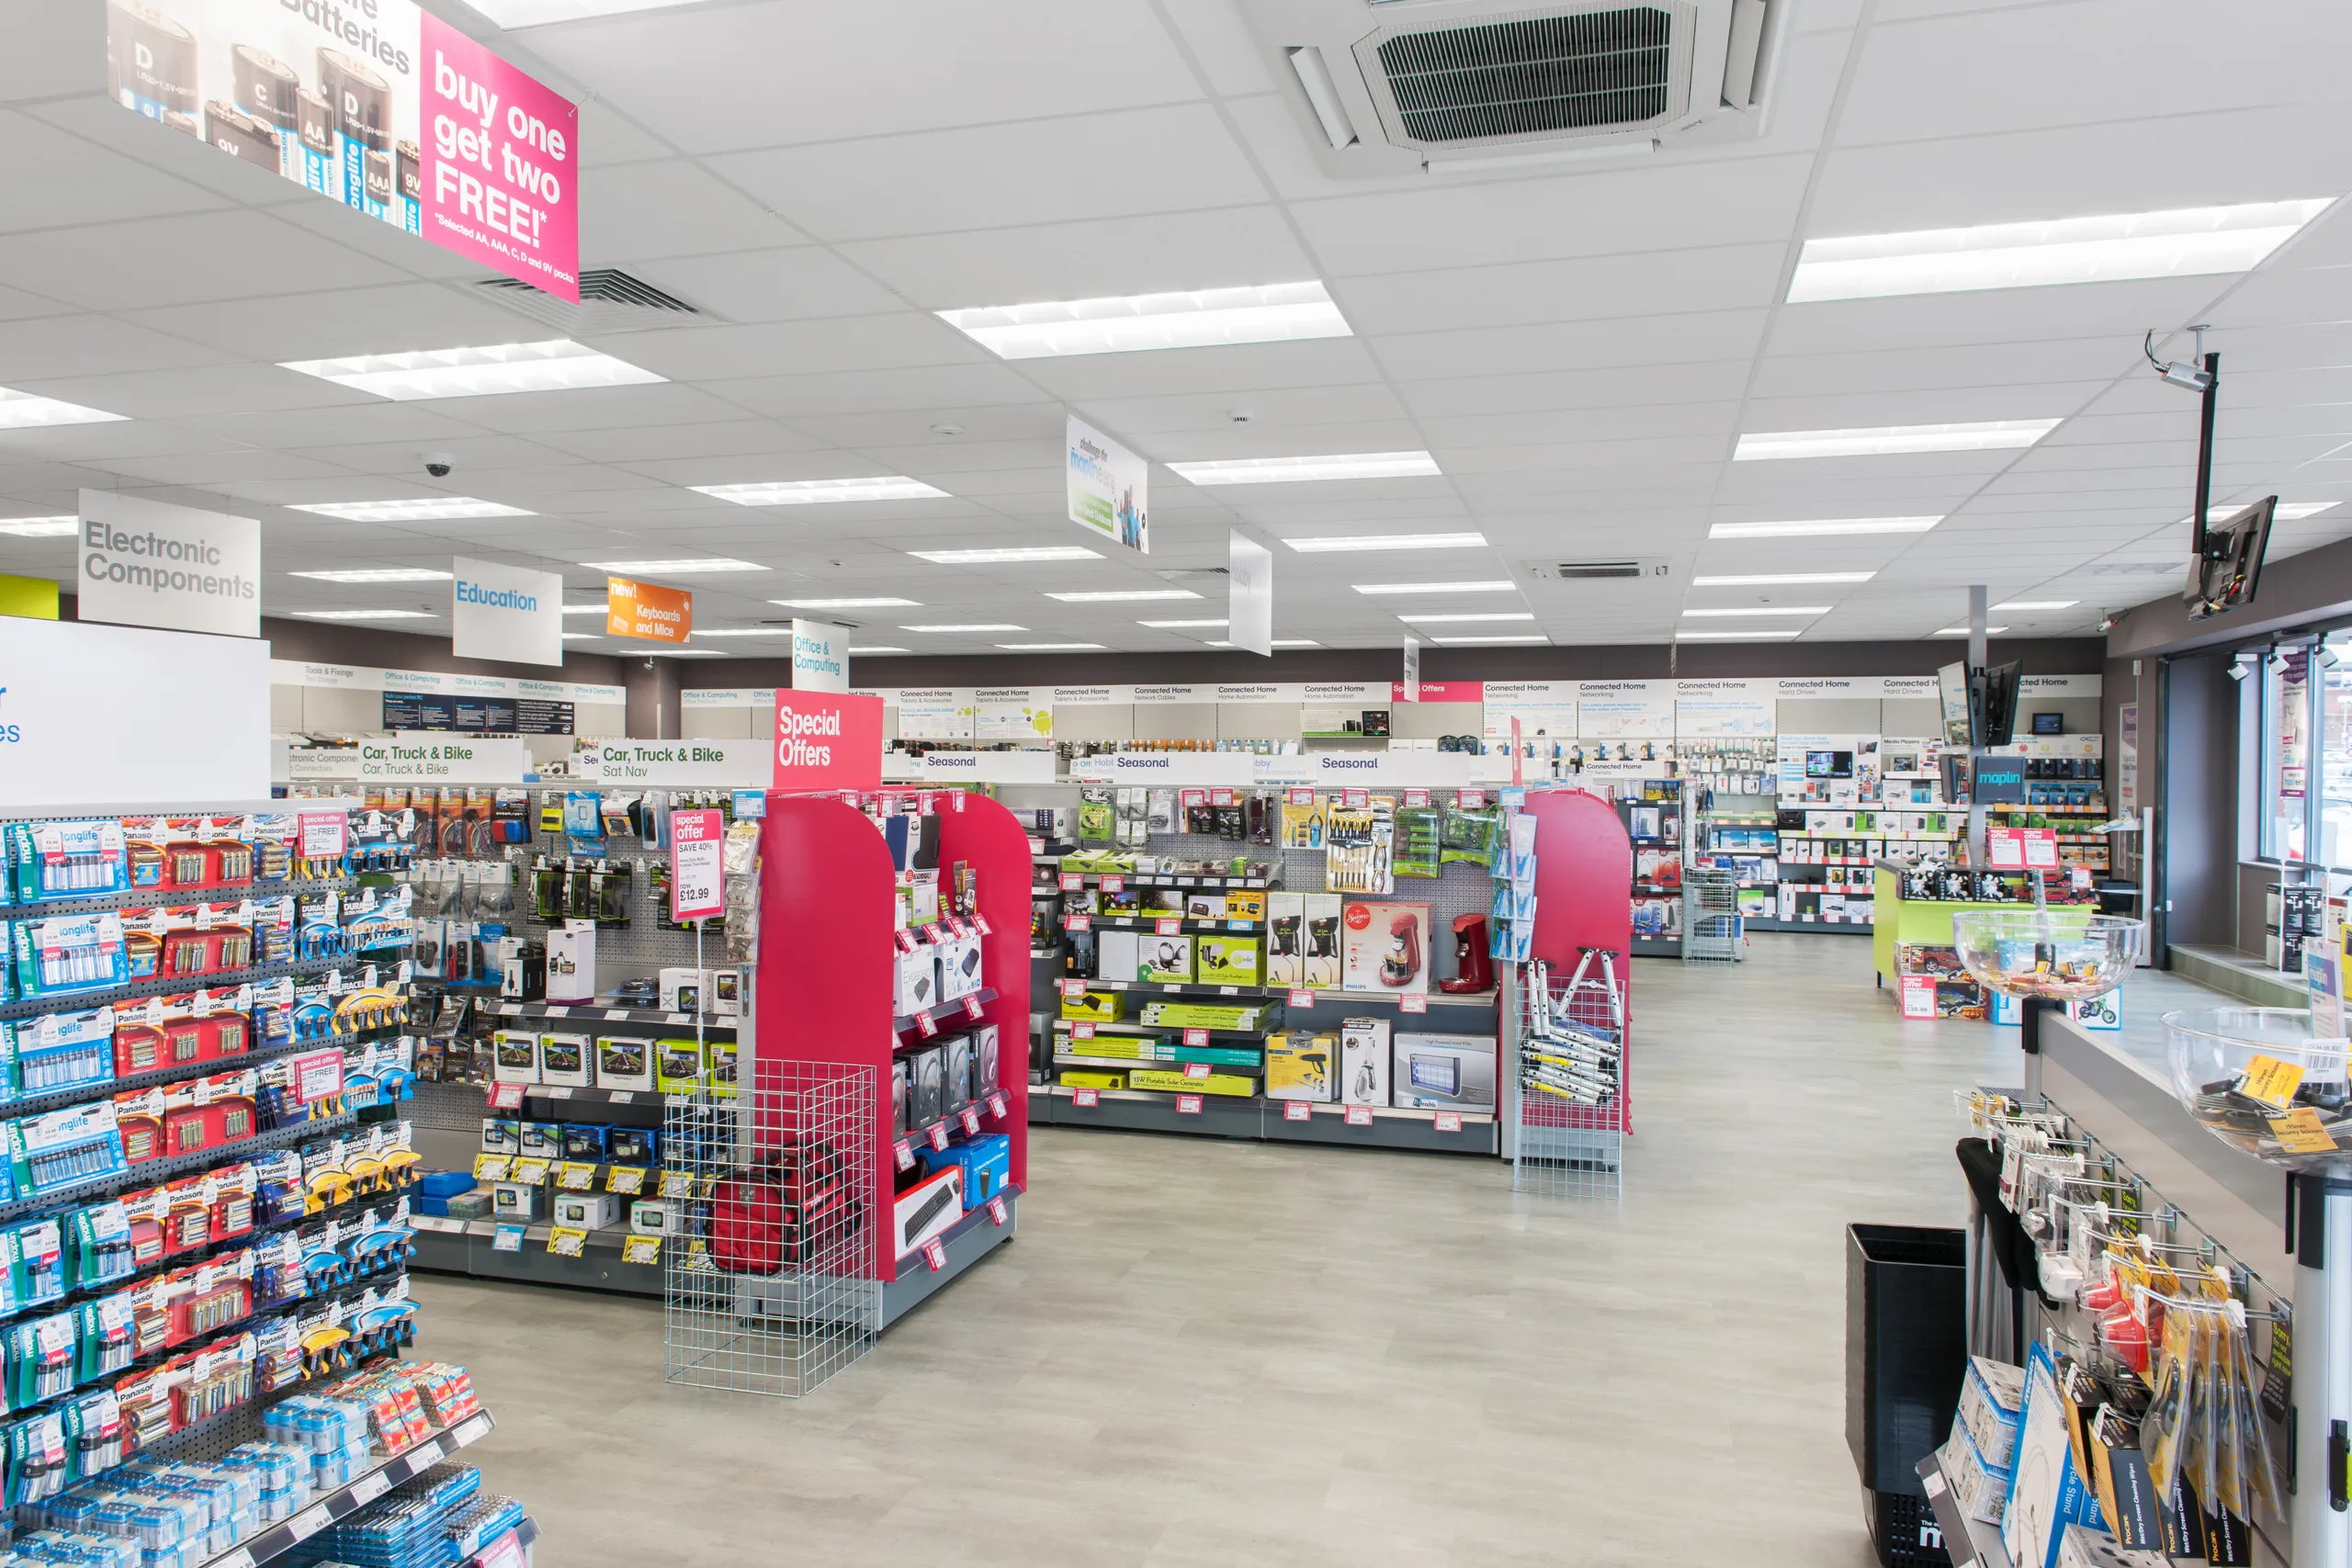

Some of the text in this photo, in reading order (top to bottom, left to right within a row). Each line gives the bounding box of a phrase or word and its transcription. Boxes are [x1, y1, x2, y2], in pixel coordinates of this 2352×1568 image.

[136, 42, 153, 69] D
[254, 84, 267, 101] C
[345, 91, 358, 116] D
[435, 49, 566, 162] buy one
[305, 120, 326, 143] AA
[435, 114, 560, 204] get two
[368, 172, 390, 191] AAA
[405, 172, 420, 191] 9V
[475, 231, 490, 247] AA,
[491, 237, 511, 256] AAA,
[511, 247, 520, 262] C,
[521, 251, 527, 262] D
[527, 256, 542, 269] and
[543, 261, 552, 274] 9V
[554, 264, 574, 284] packs
[1080, 436, 1101, 460] challenge
[1070, 450, 1115, 491] maplineers
[85, 519, 221, 568] Electronic
[85, 552, 255, 602] Components
[456, 580, 537, 613] Education
[611, 581, 638, 598] new!
[637, 604, 681, 624] Keyboards
[636, 621, 674, 637] and Mice
[794, 637, 830, 655] Office &
[305, 666, 354, 679] Tools Fixings
[794, 653, 841, 676] Computing
[385, 672, 441, 684] Office Computing
[478, 680, 506, 688] Computing
[1883, 679, 1930, 687] Connected
[2041, 678, 2068, 686] Home
[540, 683, 563, 693] Computing
[1421, 684, 1445, 693] Offers
[779, 705, 841, 737] Special
[363, 746, 473, 761] Car, Truck & Bike
[603, 747, 631, 763] Car,
[634, 748, 673, 761] Truck
[677, 748, 687, 761] &
[692, 748, 724, 761] Bike
[779, 739, 831, 766] Offers
[928, 756, 977, 767] Seasonal
[362, 763, 448, 776] Car, Truck & Bike
[603, 765, 648, 777] Sat Nav
[1117, 757, 1170, 768] Seasonal
[1322, 758, 1378, 769] Seasonal
[1979, 770, 2021, 786] maplin
[303, 816, 324, 824] special
[676, 814, 705, 840] special offer
[16, 824, 33, 864] maplin
[62, 829, 98, 842] longlife
[678, 842, 713, 852] SAVE 40%
[22, 886, 33, 895] 12
[680, 887, 709, 901] £12.99
[60, 924, 96, 937] longlife
[14, 921, 31, 962] maplin
[662, 987, 674, 1010] XL
[322, 1055, 337, 1065] offer
[1146, 1077, 1166, 1085] Portable
[1180, 1079, 1205, 1088] Generator
[8, 1122, 24, 1164] maplin
[77, 1212, 91, 1243] maplin
[8, 1231, 20, 1263] maplin
[43, 1255, 59, 1265] deal
[84, 1304, 96, 1336] maplin
[24, 1325, 34, 1359] maplin
[111, 1331, 126, 1341] deal
[51, 1353, 67, 1362] deal
[104, 1427, 118, 1438] deal
[2064, 1486, 2076, 1515] Stand
[2088, 1498, 2100, 1525] Stand
[2134, 1503, 2143, 1522] Screen
[2176, 1487, 2190, 1553] Wet/Dry Screen Cleaning
[1921, 1518, 1932, 1527] The
[2138, 1522, 2146, 1544] Wet/Dry
[2222, 1520, 2233, 1562] Wet/Dry Screen
